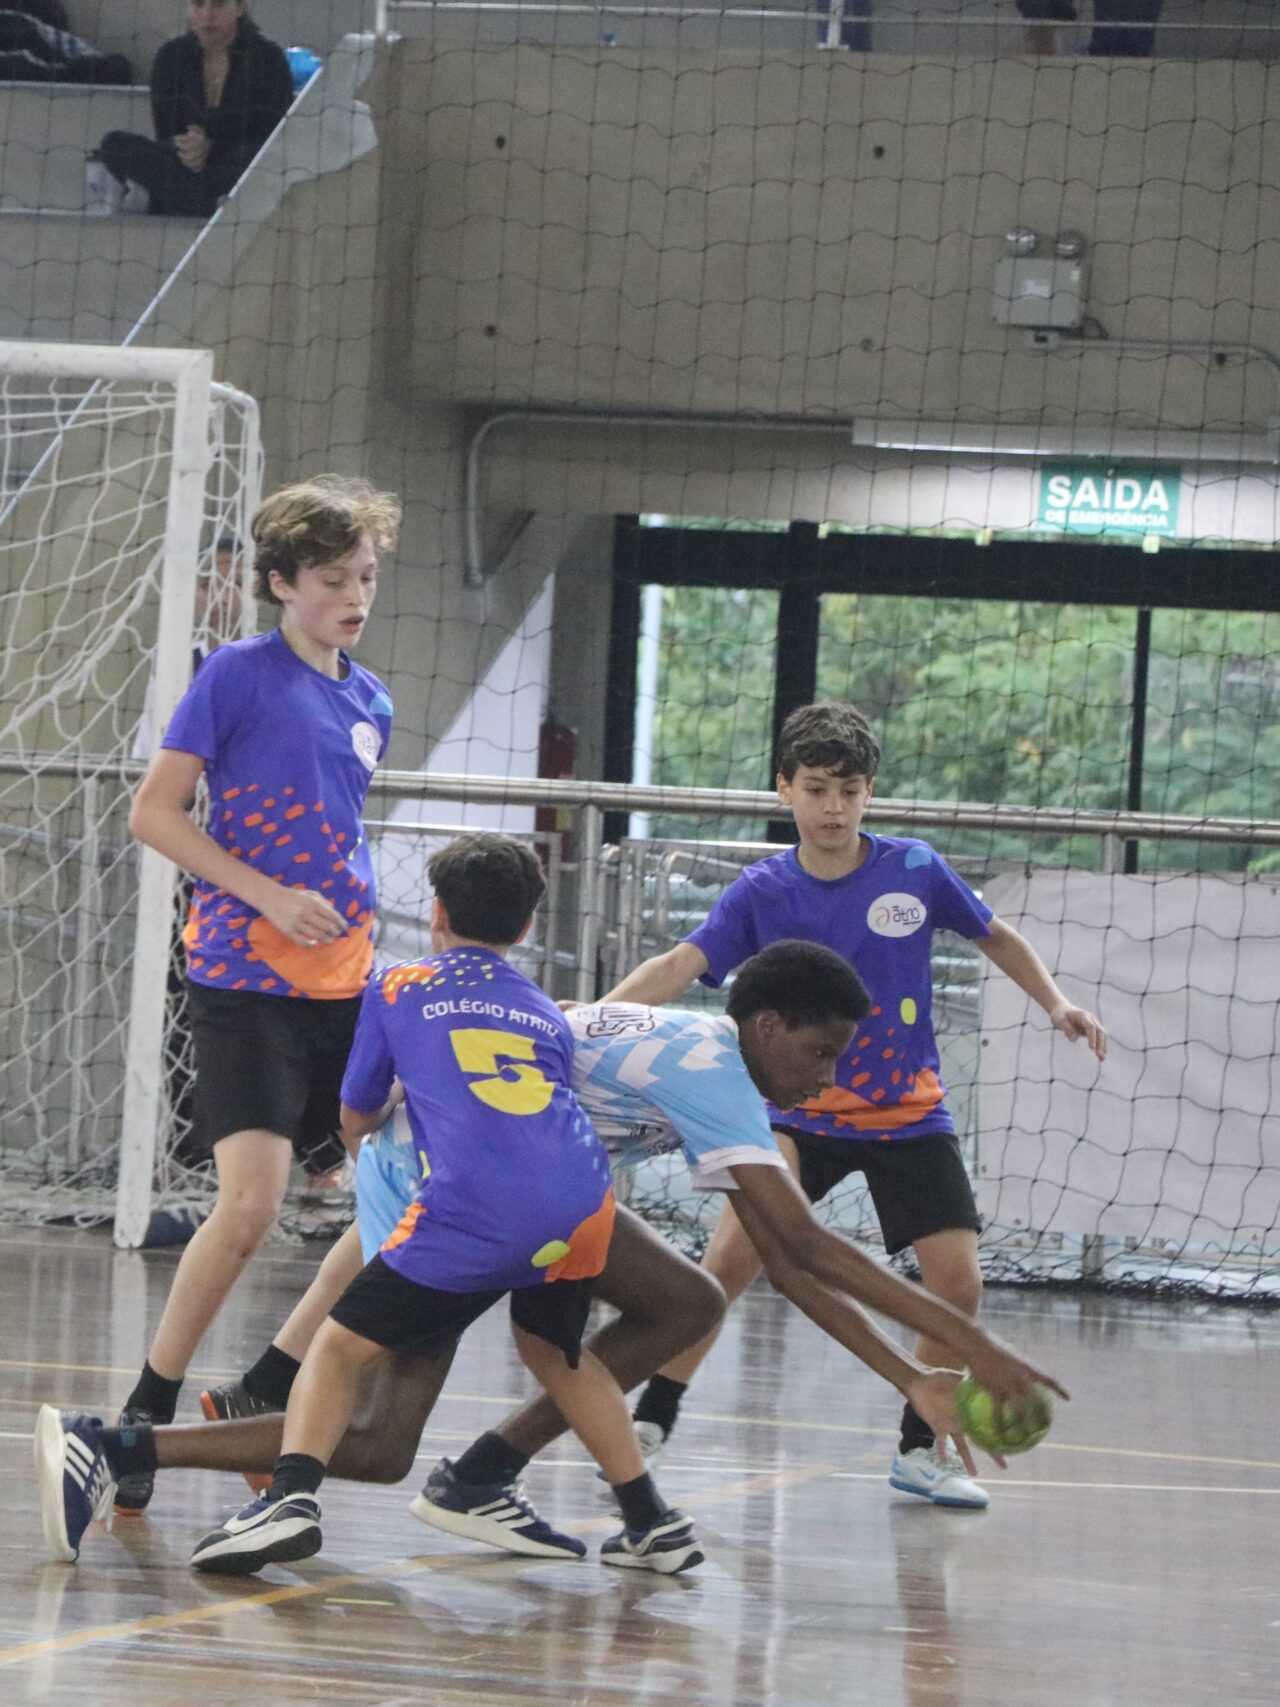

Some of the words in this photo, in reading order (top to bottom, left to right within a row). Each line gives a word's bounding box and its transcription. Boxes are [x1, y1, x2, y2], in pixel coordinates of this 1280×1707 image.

[1045, 469, 1169, 511] SAÍDA
[1068, 510, 1168, 527] EMERGÊNCIA
[422, 998, 505, 1021] COLÉGIO
[449, 1027, 555, 1116] 5
